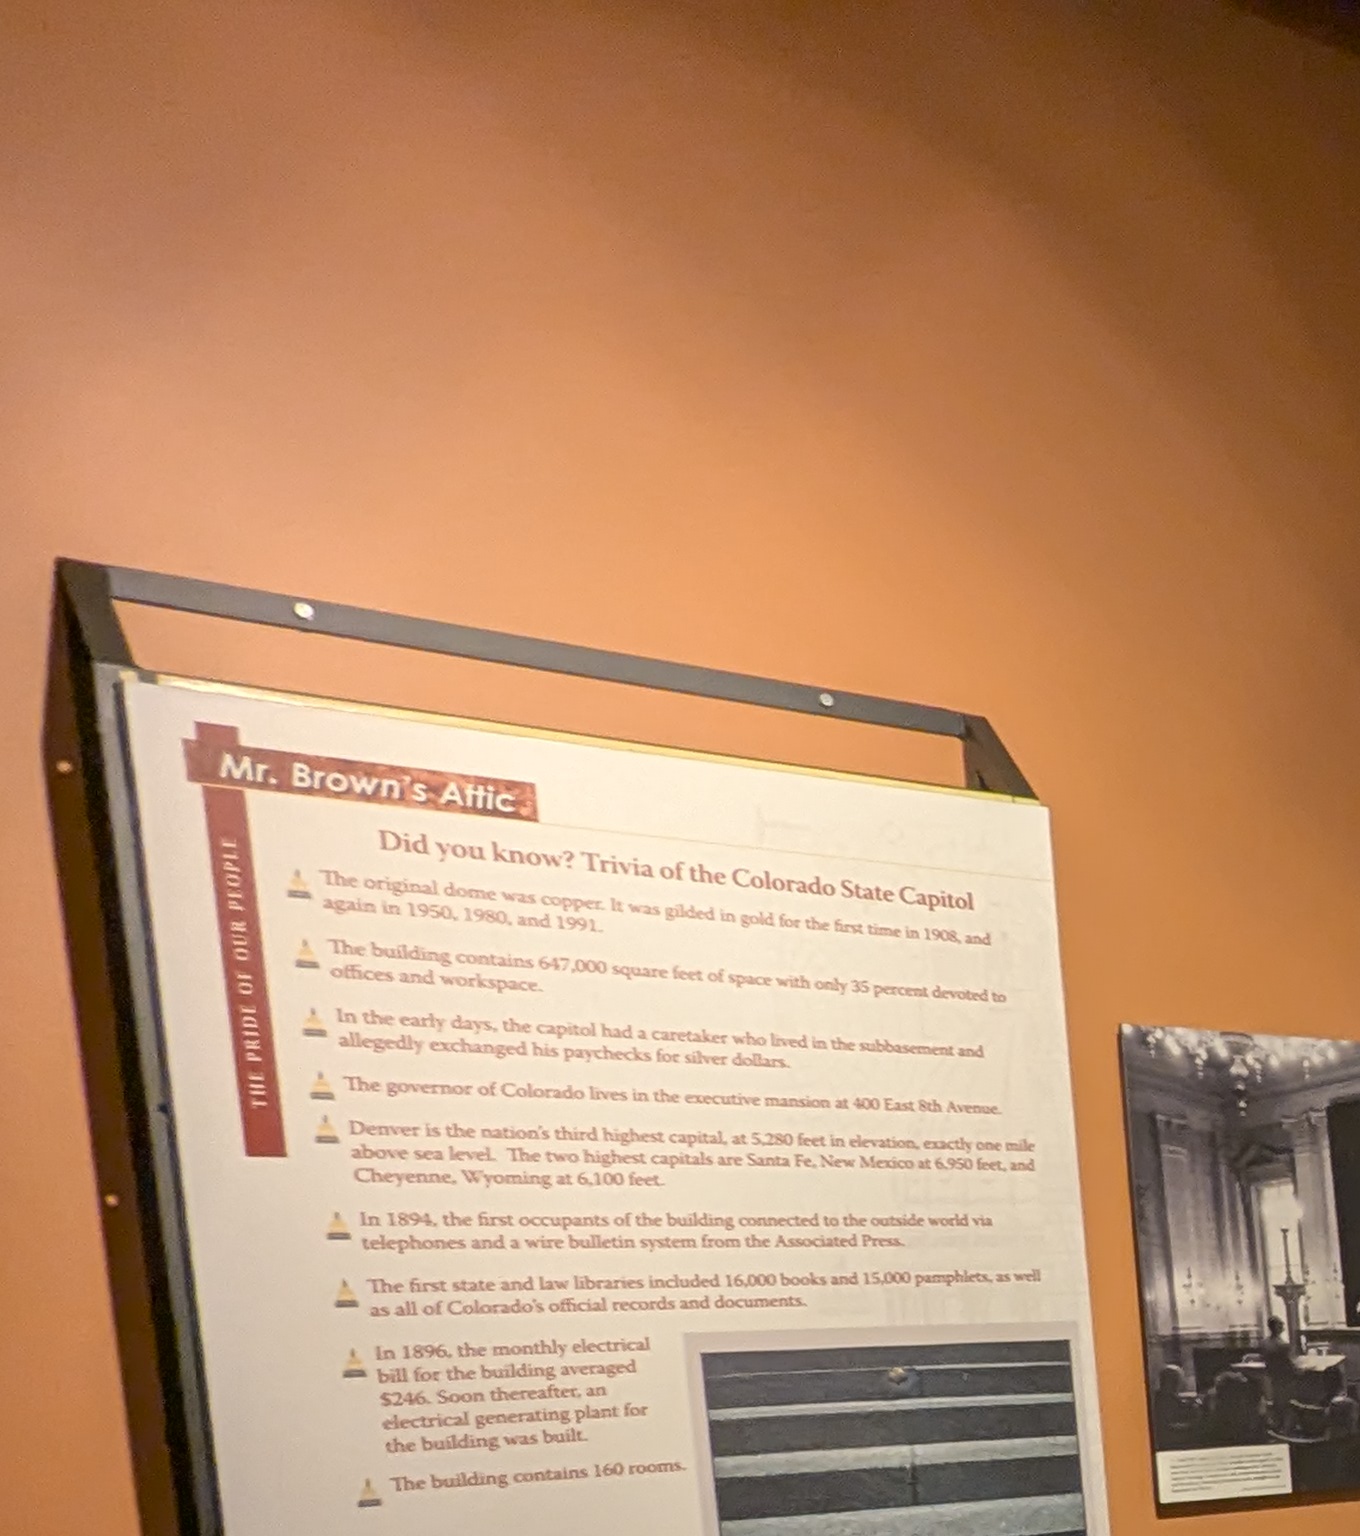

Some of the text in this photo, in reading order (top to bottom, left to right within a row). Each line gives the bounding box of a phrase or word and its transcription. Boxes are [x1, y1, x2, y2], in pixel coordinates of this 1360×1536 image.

[218, 752, 516, 814] Mr. Brown's Attic
[378, 828, 975, 913] Did you know? Trivia of the Colorado State Capitol
[318, 868, 359, 890] The
[363, 875, 440, 898] original
[443, 880, 497, 902] dome
[500, 891, 537, 906] was
[540, 894, 605, 914] copper.
[609, 896, 624, 914] It
[627, 902, 662, 917] was
[664, 902, 716, 923] gilded
[719, 907, 737, 924] in
[739, 910, 776, 930] gold
[778, 912, 802, 930] for
[804, 915, 831, 932] the
[833, 917, 864, 936] first
[866, 923, 902, 939] time
[905, 925, 921, 941] in
[964, 931, 992, 947] and
[322, 897, 377, 917] again
[381, 900, 402, 917] in
[516, 912, 553, 930] and
[556, 914, 604, 934] 1991.
[221, 837, 269, 1110] THE PRIDE OF OUR PEOPLE
[326, 937, 367, 958] The
[370, 940, 453, 969] building
[454, 952, 535, 970] contains
[611, 964, 669, 982] square
[671, 964, 704, 983] feet
[706, 967, 725, 984] of
[727, 973, 773, 990] space
[775, 974, 811, 991] with
[813, 977, 849, 996] only
[872, 983, 930, 1000] percent
[931, 984, 989, 1003] devoted
[990, 991, 1008, 1004] to
[329, 963, 544, 995] offices and workspace.
[335, 1006, 358, 1025] In
[361, 1008, 396, 1027] the
[398, 1012, 446, 1033] early
[502, 1016, 532, 1035] the
[535, 1021, 597, 1041] capitol
[600, 1022, 634, 1040] had
[637, 1029, 648, 1041] a
[650, 1027, 729, 1045] caretaker
[731, 1030, 768, 1047] who
[769, 1032, 809, 1050] lived
[811, 1036, 828, 1050] in
[829, 1036, 857, 1053] the
[858, 1038, 955, 1057] subbasement
[956, 1043, 985, 1059] and
[337, 1030, 791, 1069] allegedly exchanged his paychecks for silver dollars.
[342, 1074, 382, 1094] The
[385, 1080, 474, 1098] governor
[476, 1080, 497, 1098] of
[500, 1081, 586, 1101] Colorado
[588, 1084, 629, 1103] lives
[632, 1087, 650, 1103] in
[652, 1088, 681, 1104] the
[683, 1092, 761, 1107] executive
[763, 1094, 832, 1110] mansion
[834, 1097, 850, 1111] at
[882, 1096, 916, 1114] East
[946, 1100, 1002, 1116] Avenue.
[359, 1211, 382, 1227] In
[441, 1210, 474, 1227] the
[477, 1211, 515, 1227] first
[518, 1214, 611, 1232] occupants
[613, 1211, 633, 1228] of
[634, 1211, 663, 1228] the
[665, 1211, 736, 1232] building
[737, 1212, 821, 1228] connected
[822, 1215, 840, 1228] to
[842, 1212, 868, 1228] the
[869, 1213, 926, 1228] outside
[927, 1213, 970, 1227] world
[971, 1217, 994, 1227] via
[361, 1233, 906, 1255] telephones and a wire bulletin system from the Associated Press.
[375, 1344, 397, 1361] In
[456, 1341, 488, 1359] the
[492, 1337, 568, 1359] monthly
[571, 1336, 651, 1355] electrical
[376, 1358, 638, 1385] bill for the building averaged
[384, 1426, 589, 1455] the building was built.
[388, 1475, 427, 1493] The
[429, 1470, 510, 1490] building
[512, 1466, 589, 1485] contains
[628, 1461, 687, 1476] rooms.
